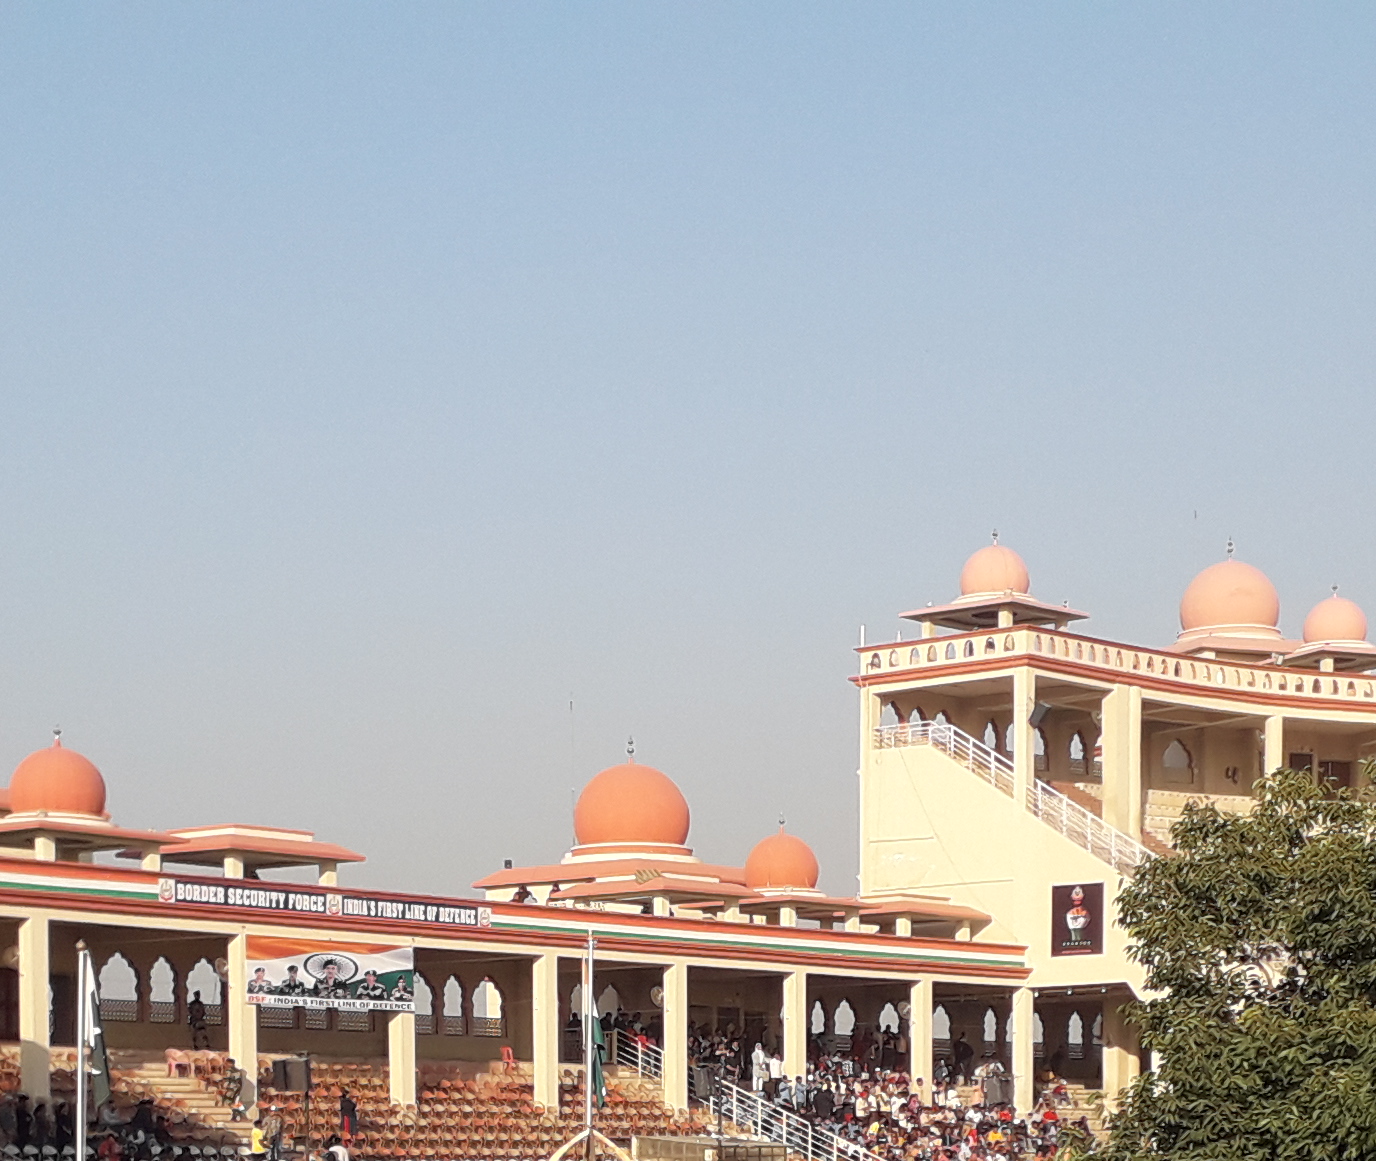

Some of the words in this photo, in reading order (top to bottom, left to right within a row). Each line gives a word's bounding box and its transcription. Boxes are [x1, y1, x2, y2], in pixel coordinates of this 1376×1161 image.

[176, 883, 225, 903] BORDER
[227, 888, 286, 908] SECURITY
[288, 893, 325, 911] FORCE
[343, 898, 376, 917] INDIA'S
[377, 901, 404, 919] FIRST
[405, 903, 426, 921] LINE
[426, 905, 438, 922] OF
[438, 907, 476, 925] DEFENCE
[310, 999, 336, 1008] FIRST
[337, 1001, 358, 1009] LINE
[359, 1001, 371, 1009] OF
